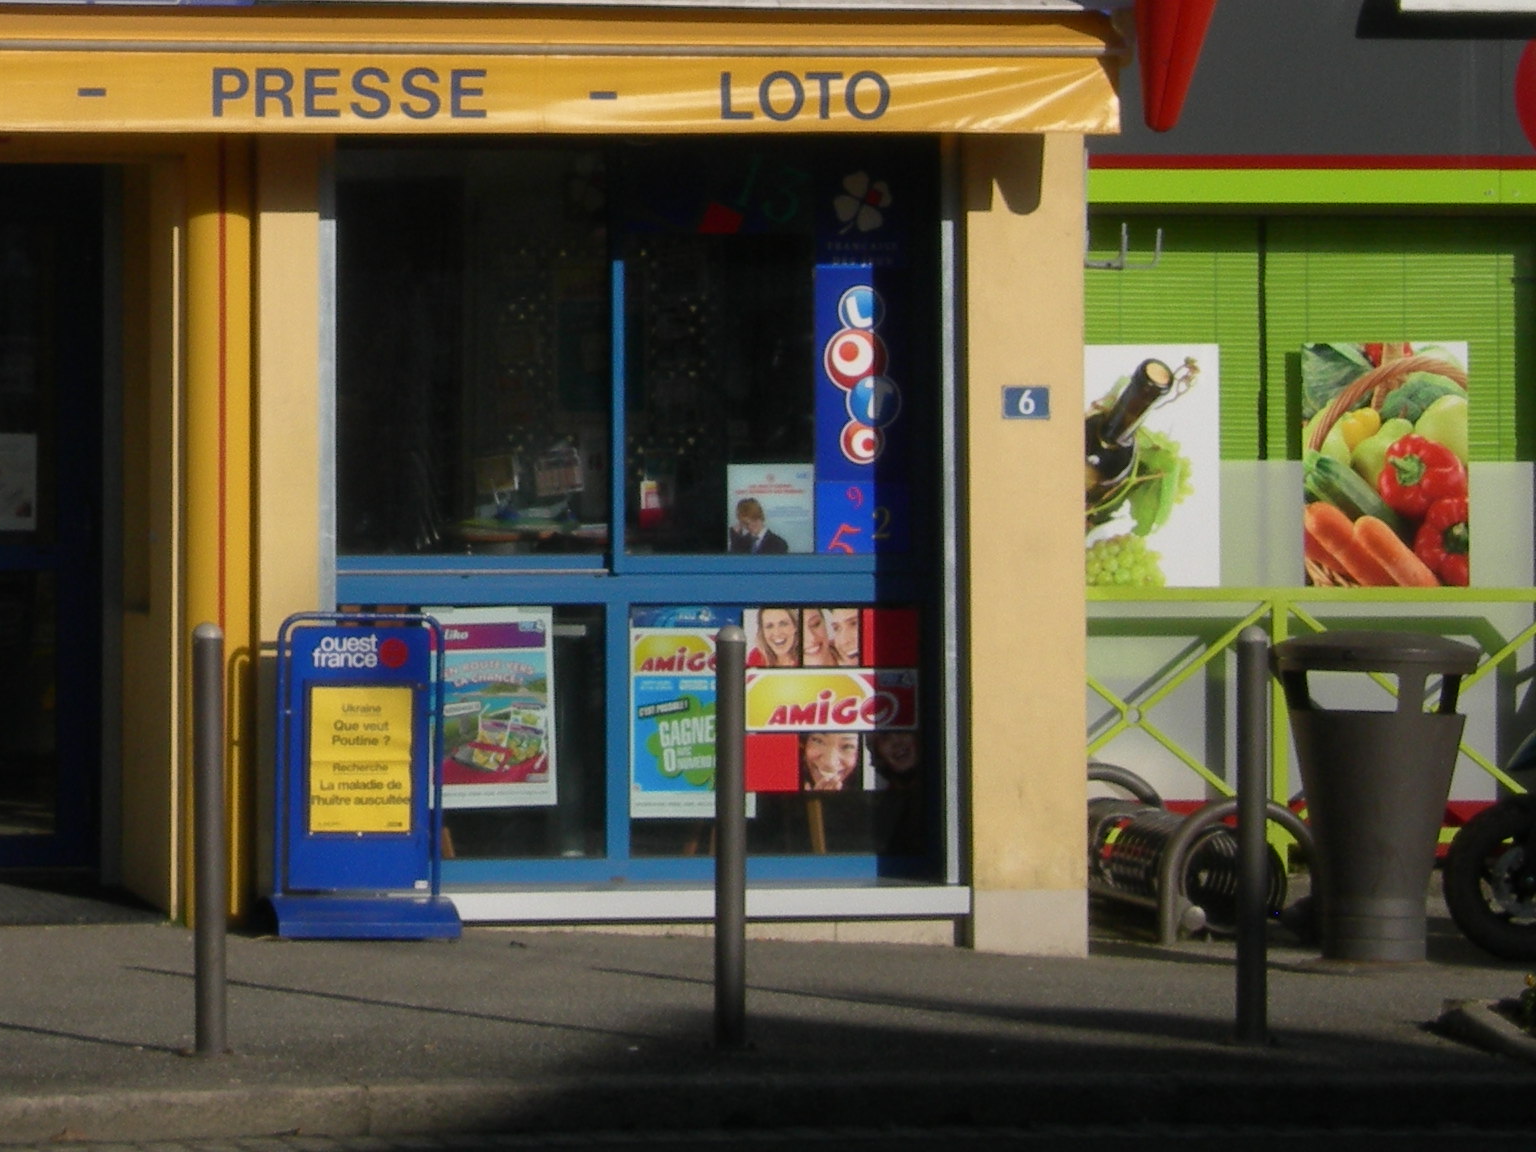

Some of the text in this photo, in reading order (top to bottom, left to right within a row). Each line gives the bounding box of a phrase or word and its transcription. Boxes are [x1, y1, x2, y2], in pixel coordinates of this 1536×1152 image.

[77, 88, 106, 97] -
[211, 67, 488, 120] PRESSE
[589, 90, 617, 100] -
[719, 70, 891, 122] LOTO
[1018, 389, 1035, 415] 6
[320, 633, 378, 652] ouest
[312, 647, 378, 668] france
[342, 703, 382, 714] Ukraine
[332, 719, 390, 732] Que veut
[659, 715, 716, 748] GAGNE
[331, 734, 391, 746] Poutine ?
[332, 762, 389, 772] Recherche
[319, 779, 402, 791] La maladie de
